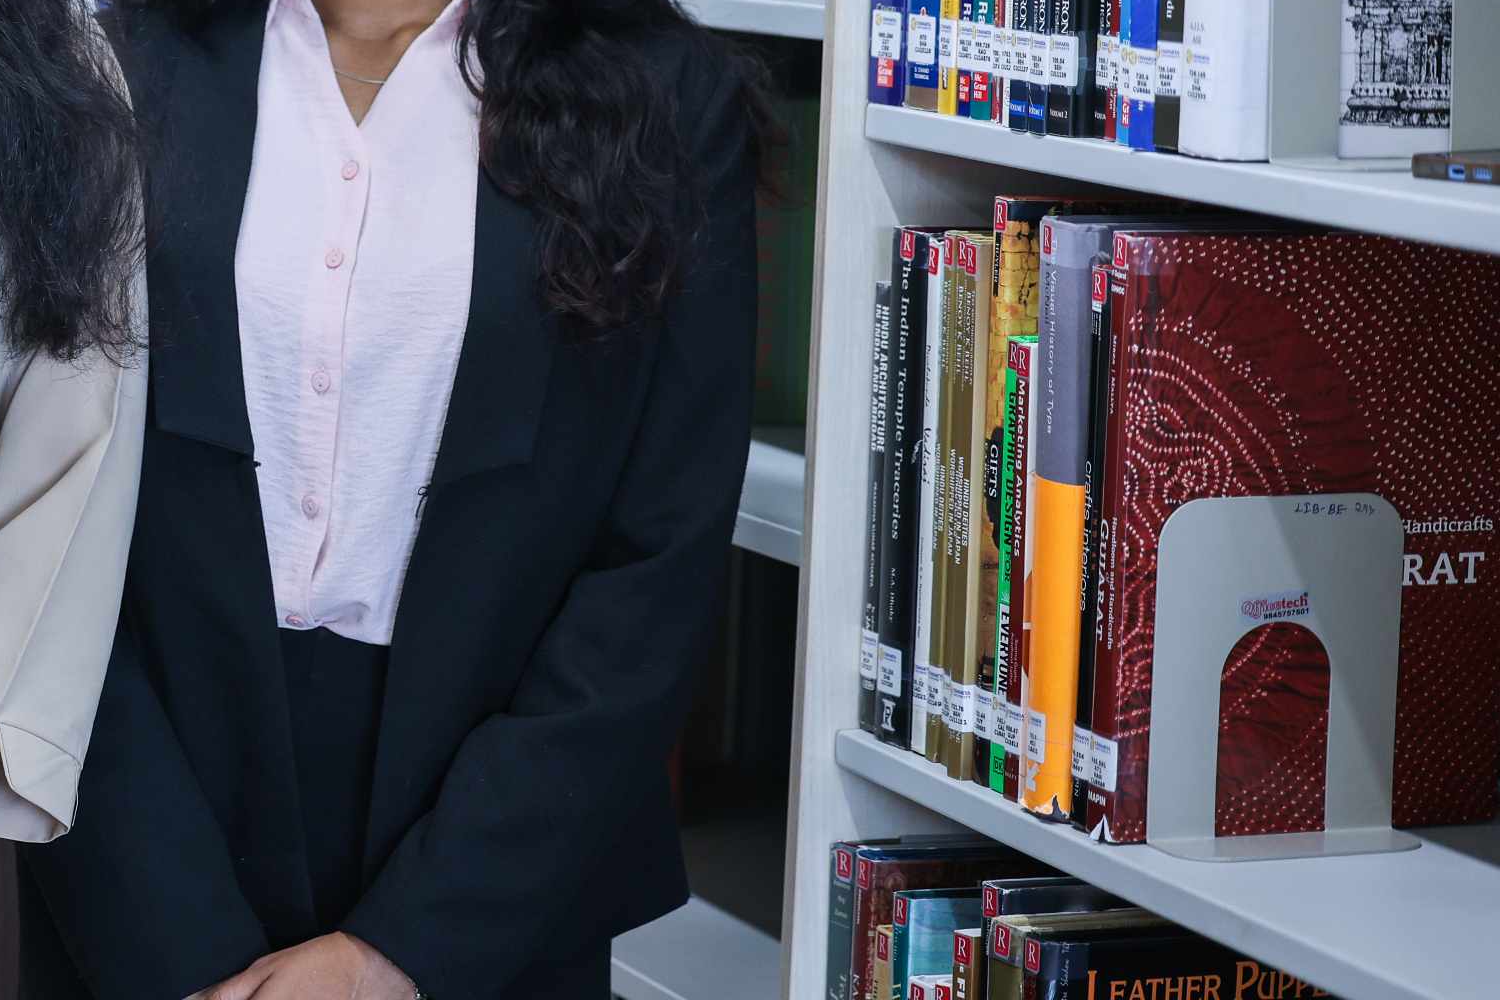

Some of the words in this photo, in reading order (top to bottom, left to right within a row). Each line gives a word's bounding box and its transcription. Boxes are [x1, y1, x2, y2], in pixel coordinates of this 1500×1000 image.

[1049, 270, 1057, 315] Visual
[873, 322, 881, 360] INDIA
[880, 306, 890, 350] HINDU
[899, 296, 910, 361] Indian
[1047, 321, 1056, 375] History
[876, 353, 888, 453] ARCHITECTURE
[895, 367, 907, 442] Temple
[1047, 380, 1054, 395] of
[871, 396, 879, 450] ABROAD
[1006, 391, 1017, 472] GRAPHIC
[1014, 379, 1026, 470] Marketing
[1045, 399, 1054, 434] Type
[891, 448, 903, 540] Traceries
[962, 478, 970, 509] HINDU
[988, 443, 999, 498] GIFTS
[1083, 460, 1093, 521] Crafts
[961, 511, 969, 547] DEITIES
[1003, 479, 1015, 545] DESIGN
[1013, 474, 1024, 557] Analytics
[1402, 514, 1494, 535] Handicrafts
[1109, 516, 1118, 569] Handloom
[1402, 551, 1485, 587] RAT
[1080, 528, 1091, 612] interiors
[1096, 519, 1110, 641] GUJARAT
[1107, 593, 1115, 650] Handicrafts
[957, 939, 967, 958] R
[1087, 970, 1221, 1000] LEATHER
